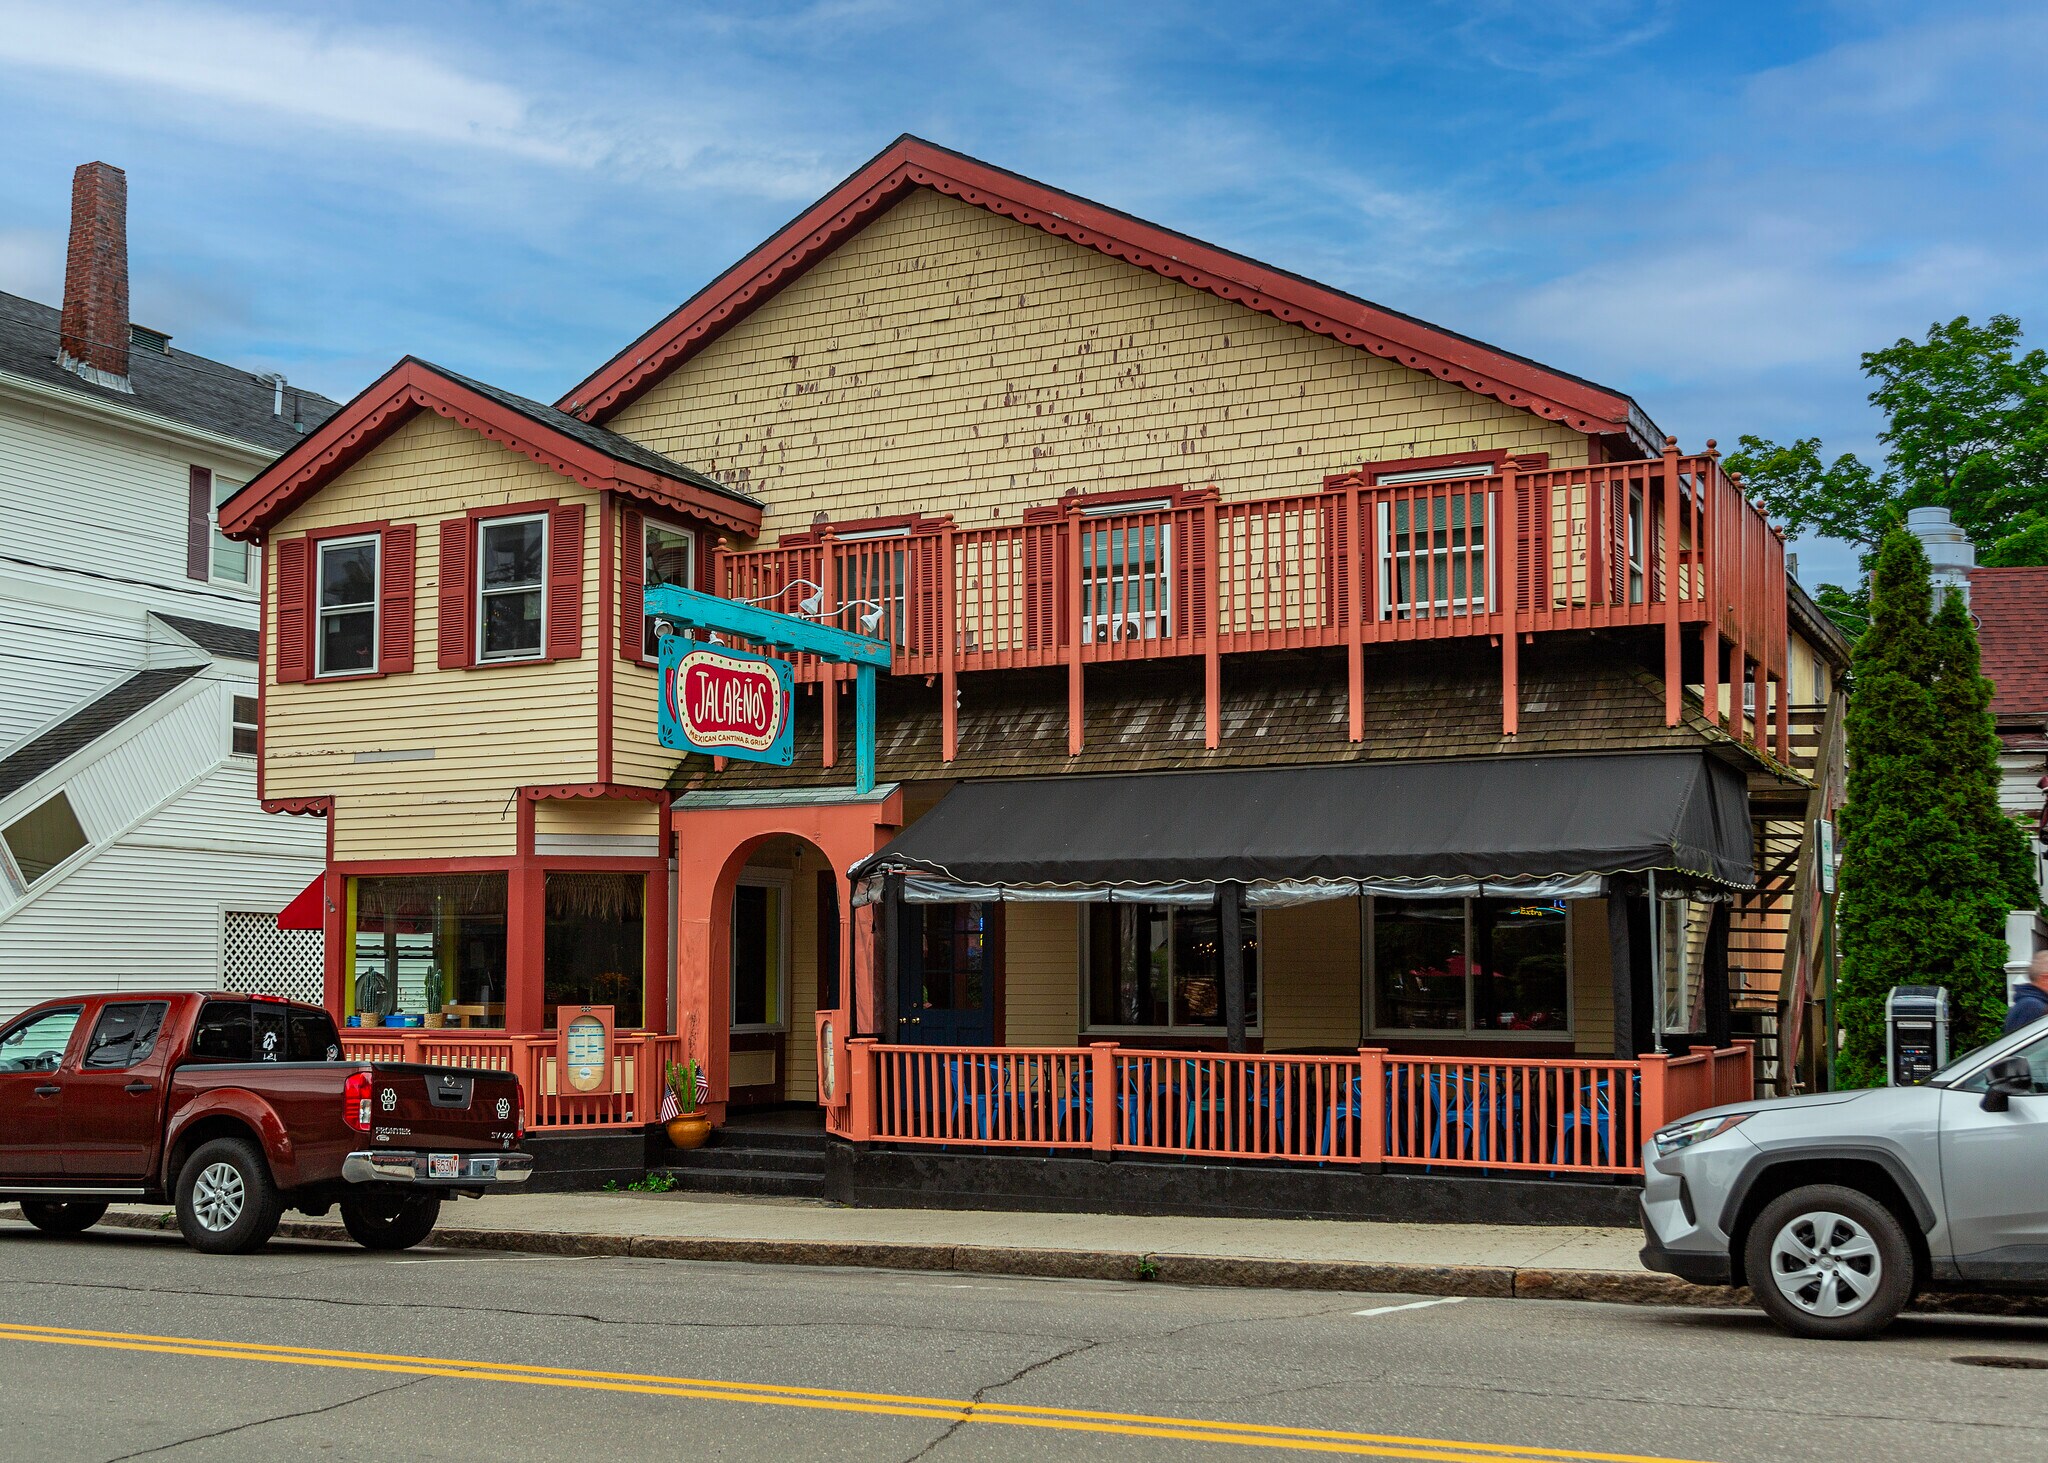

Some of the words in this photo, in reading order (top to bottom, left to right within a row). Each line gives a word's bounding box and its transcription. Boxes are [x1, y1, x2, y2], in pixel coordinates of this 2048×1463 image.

[688, 730, 716, 743] MEXICAN
[718, 734, 744, 743] CANTINA
[750, 738, 769, 746] GRILL
[1519, 906, 1543, 917] Extra
